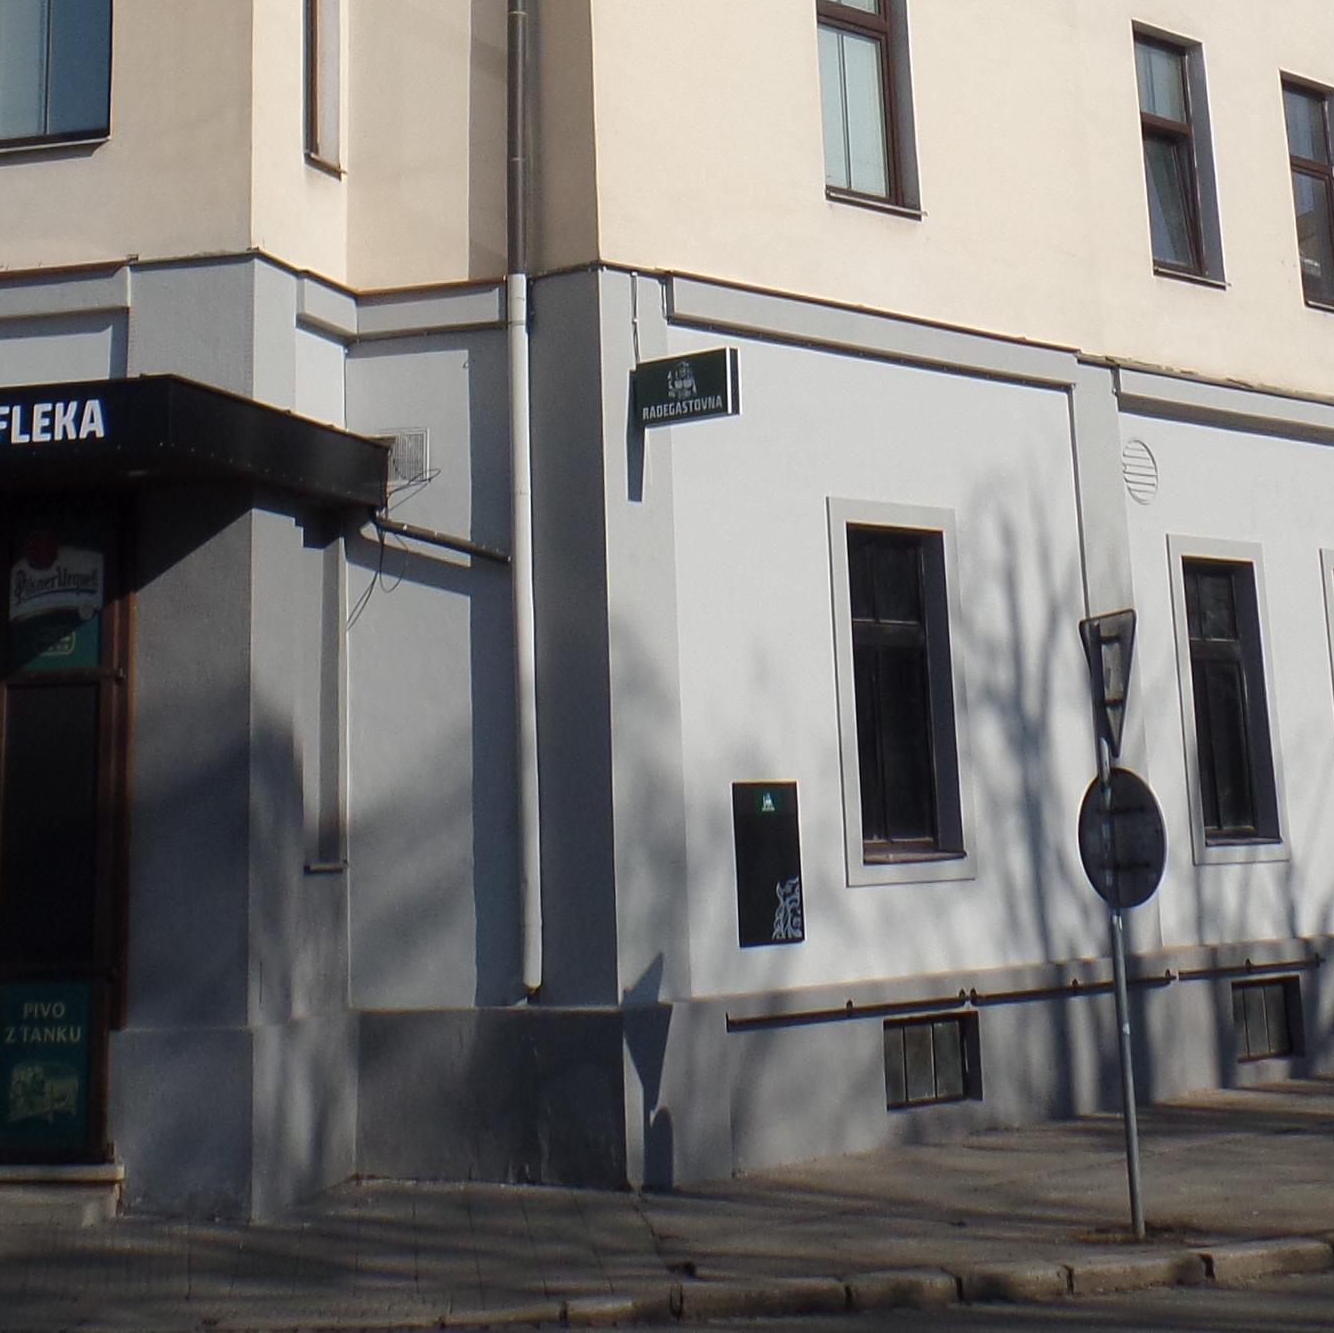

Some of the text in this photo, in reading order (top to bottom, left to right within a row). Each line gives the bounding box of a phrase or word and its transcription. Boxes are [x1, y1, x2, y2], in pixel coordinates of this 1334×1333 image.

[642, 395, 723, 421] RADEGASTOVNA
[23, 1001, 66, 1020] PIVO
[5, 1026, 82, 1045] Z TANKU
